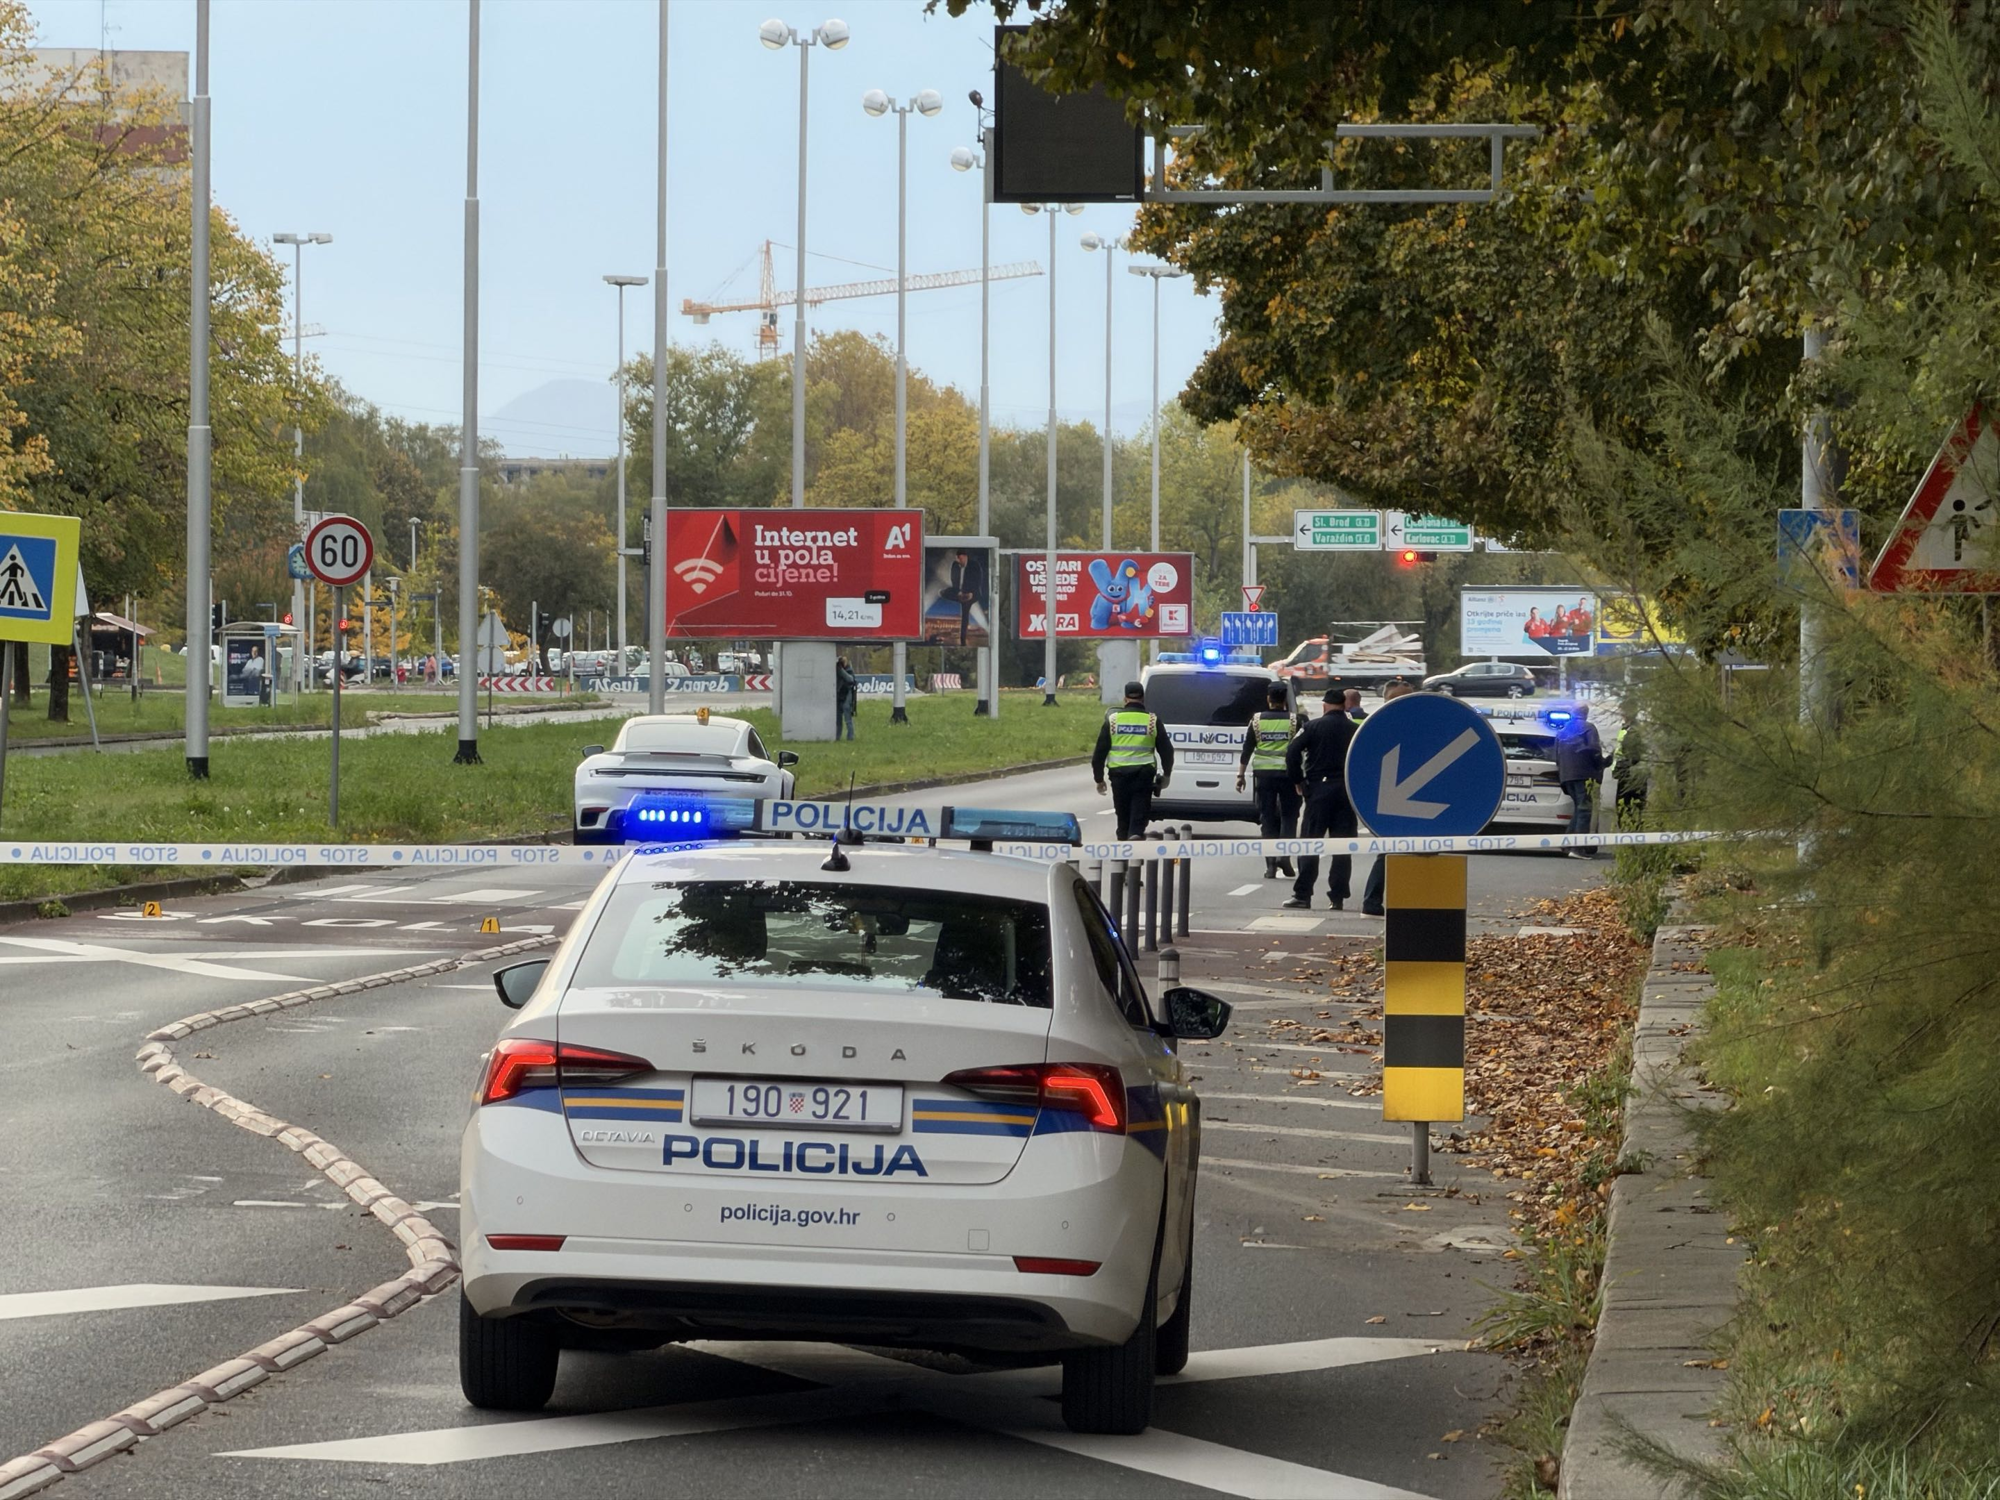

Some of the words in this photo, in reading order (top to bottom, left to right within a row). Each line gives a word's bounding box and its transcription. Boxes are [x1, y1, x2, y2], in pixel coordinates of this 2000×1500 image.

[1329, 517, 1350, 527] Brod
[754, 524, 858, 547] Internet
[884, 522, 911, 550] A1
[1314, 532, 1354, 543] Varaždin
[320, 534, 359, 567] 60
[754, 549, 771, 565] u
[779, 544, 834, 570] pola
[754, 562, 839, 587] cijene!
[1029, 571, 1078, 585] UŠEDE
[832, 610, 859, 621] 14,21
[588, 677, 643, 692] Novi
[700, 708, 707, 718] 5
[771, 801, 931, 834] POLICIJA
[147, 903, 156, 916] 2
[486, 919, 493, 931] 1
[692, 1038, 908, 1061] ŠKODA
[727, 1085, 783, 1118] 190
[811, 1087, 868, 1121] 921
[581, 1129, 655, 1143] OCTAVIA
[662, 1133, 930, 1177] POLICIJA
[720, 1203, 861, 1227] policija.gov.hr
